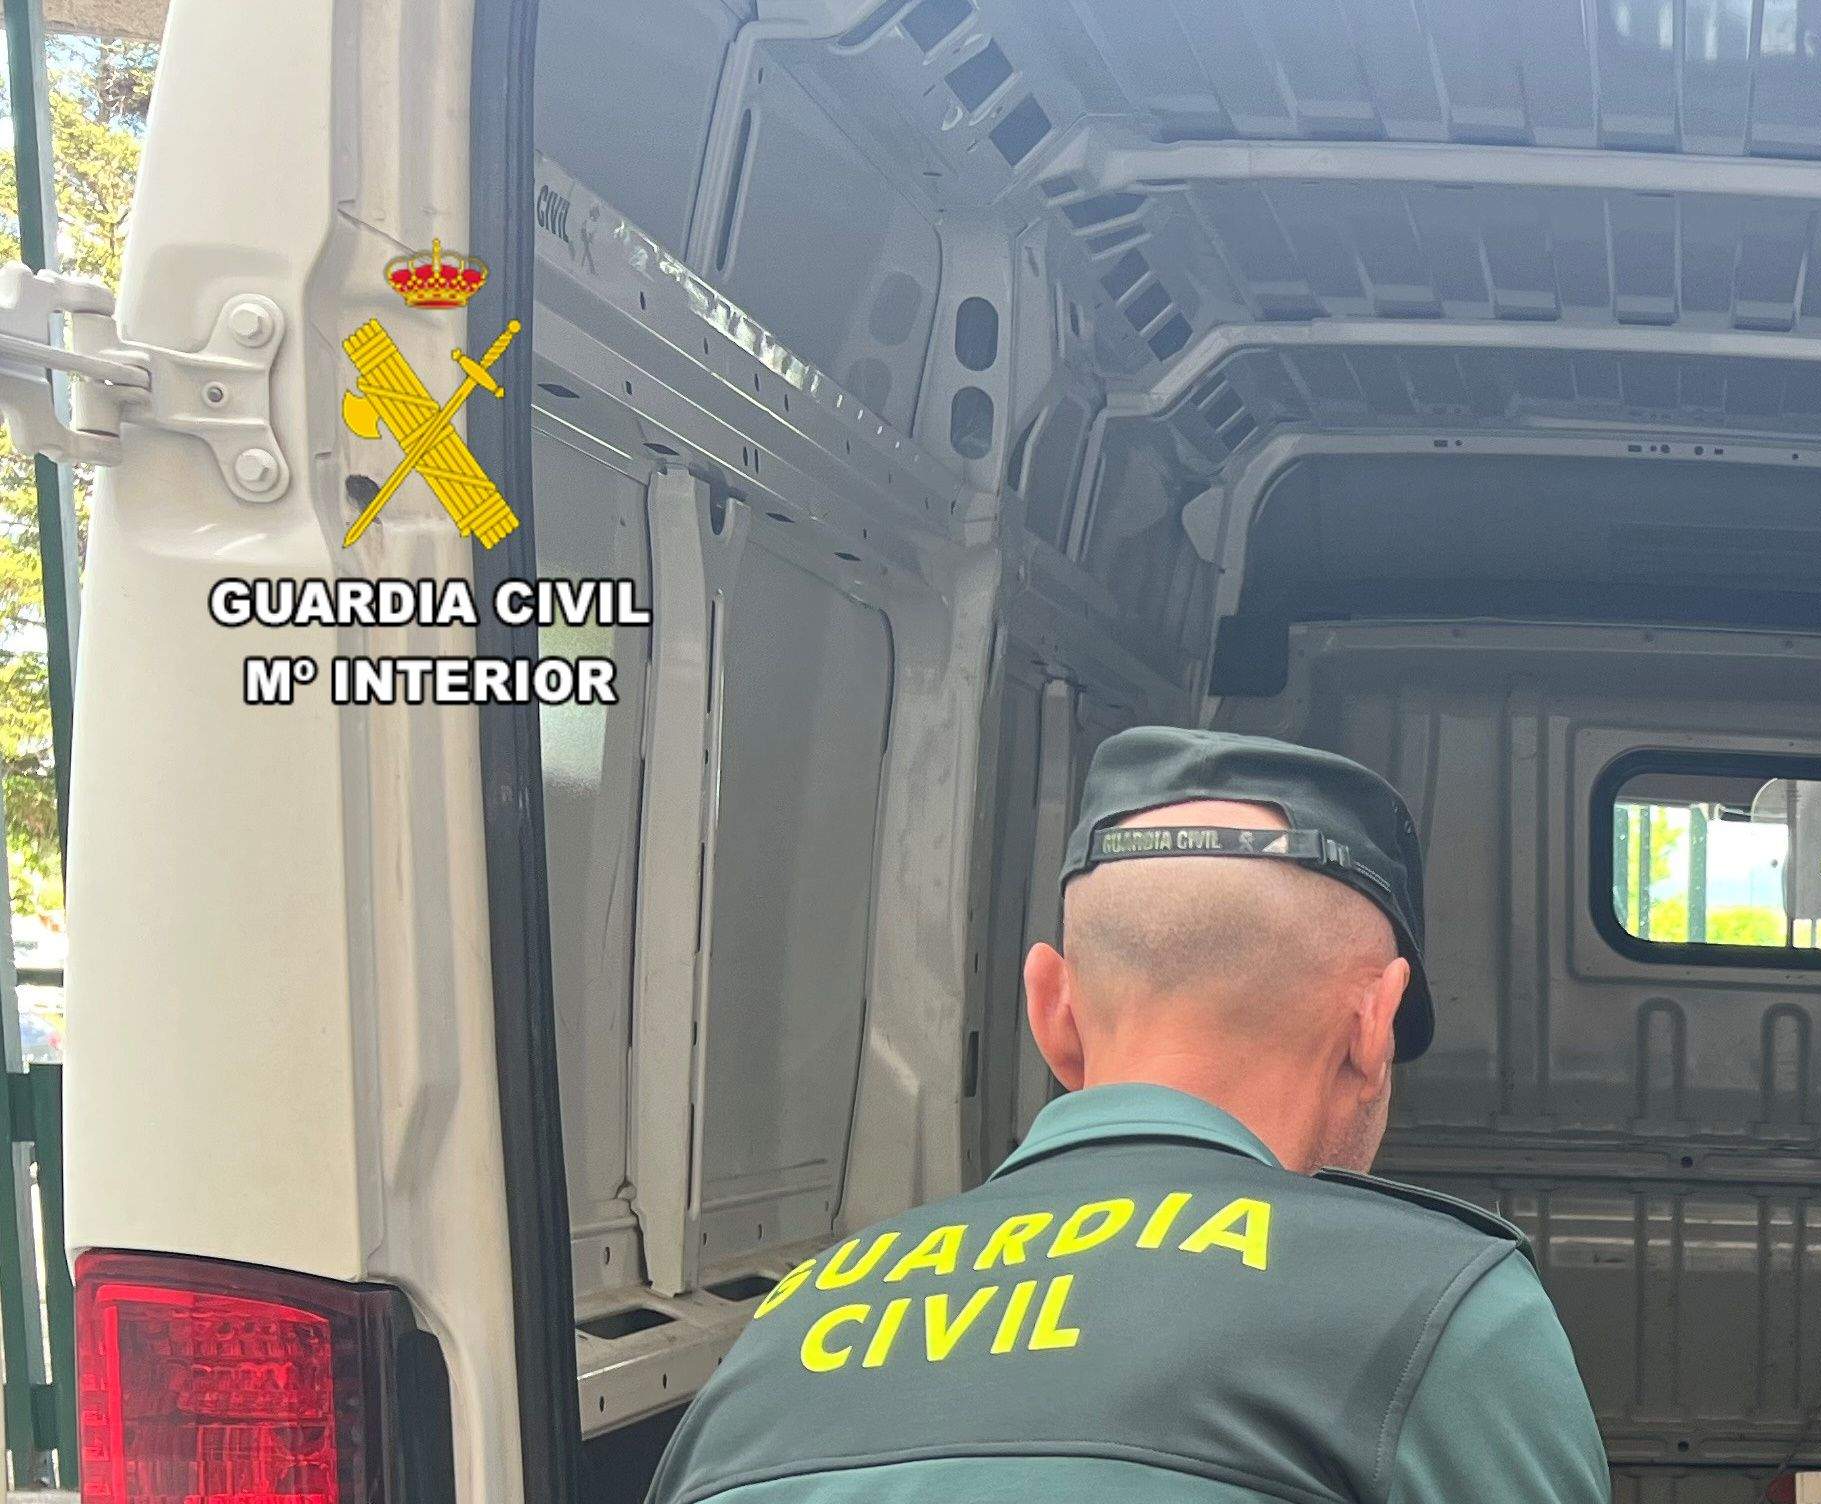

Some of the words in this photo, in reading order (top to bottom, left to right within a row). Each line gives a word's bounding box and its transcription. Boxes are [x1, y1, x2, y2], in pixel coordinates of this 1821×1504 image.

[537, 184, 571, 244] CIVIL
[1102, 830, 1171, 853] GUARDIA
[1177, 830, 1221, 851] CIVIL
[754, 1192, 1272, 1319] GUARDIA
[800, 1274, 1081, 1373] CIVIL
